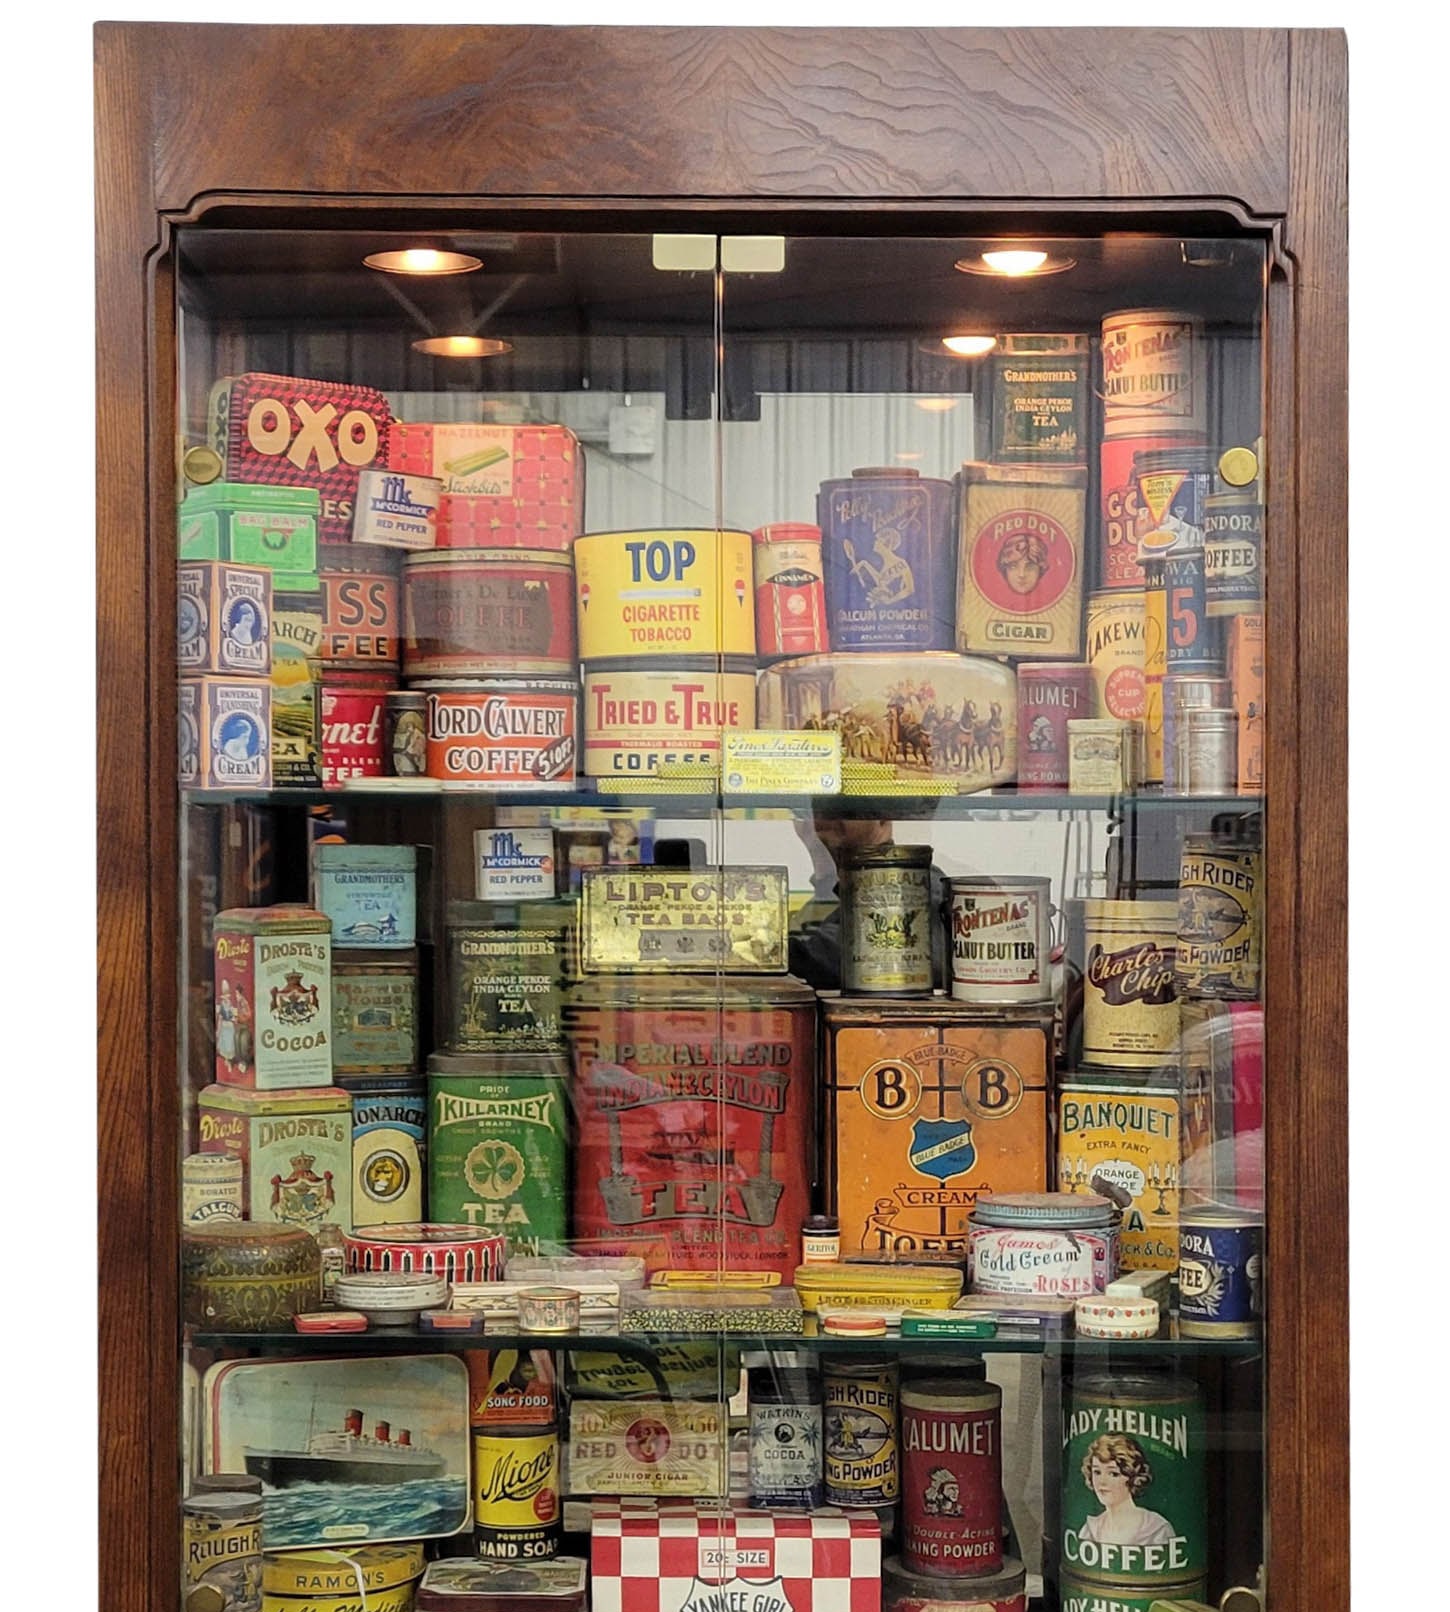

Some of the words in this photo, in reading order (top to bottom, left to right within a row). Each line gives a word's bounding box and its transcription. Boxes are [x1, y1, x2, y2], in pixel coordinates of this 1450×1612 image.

[1032, 416, 1059, 427] TEA
[247, 397, 379, 474] OXO
[240, 516, 265, 526] BAG
[272, 517, 307, 527] BALM
[376, 519, 393, 529] RED
[396, 522, 427, 534] PEPPER
[993, 516, 1023, 540] RED
[1027, 515, 1059, 542] DOT
[625, 540, 696, 583] TOP
[1205, 548, 1253, 568] OFFEE
[622, 604, 701, 623] CIGARETTE
[1173, 587, 1197, 647] 5
[629, 627, 692, 642] TOBACCO
[991, 623, 1048, 640] CIGAR
[227, 643, 263, 659] CREAM
[1118, 689, 1139, 697] CUP
[592, 684, 657, 730] TRIED
[664, 701, 680, 725] &
[671, 684, 739, 730] TRUE
[429, 696, 481, 738] LORD
[485, 696, 565, 737] CALVERT
[218, 759, 260, 775] CREAM
[449, 750, 533, 771] COFFE
[489, 875, 507, 884] RED
[510, 874, 543, 884] PEPPER
[1201, 862, 1254, 893] RIDER
[626, 913, 671, 925] TEA
[682, 913, 744, 925] BAGS
[260, 942, 326, 963] DROSTE'S
[987, 942, 1035, 960] BUTTER
[1190, 946, 1250, 965] POWDER
[1091, 945, 1164, 981] Charles
[473, 976, 516, 985] ORANGE
[473, 985, 504, 994] INDIA
[505, 985, 551, 994] CEYLON
[498, 999, 533, 1013] TEA
[261, 1030, 327, 1051] COCOA
[913, 1051, 936, 1061] BLUE
[479, 1085, 509, 1094] PRIDE
[876, 1065, 907, 1111] B
[977, 1065, 1010, 1111] B
[444, 1098, 550, 1122] KILLARNEY
[1064, 1103, 1173, 1138] BANQUET
[259, 1118, 345, 1149] DROSTE'S
[1087, 1141, 1117, 1150] EXTRA
[1121, 1141, 1151, 1154] FANCY
[1096, 1169, 1140, 1179] ORANGE
[634, 1183, 749, 1217] TEA
[908, 1191, 978, 1205] CREAM
[461, 1203, 531, 1225] TEA
[980, 1249, 1016, 1272] Cold
[1020, 1251, 1079, 1269] Cream
[1037, 1275, 1090, 1292] ROSES
[487, 1397, 515, 1407] SONG
[518, 1396, 548, 1406] FOOD
[848, 1386, 896, 1407] RIDER
[903, 1417, 994, 1455] CALUMET
[1062, 1408, 1101, 1448] LADY
[1104, 1408, 1187, 1457] HELLEN
[576, 1444, 616, 1458] RED
[764, 1450, 805, 1460] COCOA
[655, 1473, 688, 1481] CIGAR
[842, 1459, 896, 1481] POWDER
[496, 1532, 545, 1541] POWDERED
[479, 1541, 520, 1557] HAND
[943, 1541, 995, 1557] POWDER
[1064, 1529, 1187, 1572] COFFEE
[737, 1553, 766, 1564] SIZE
[296, 1572, 385, 1589] RAMON'S
